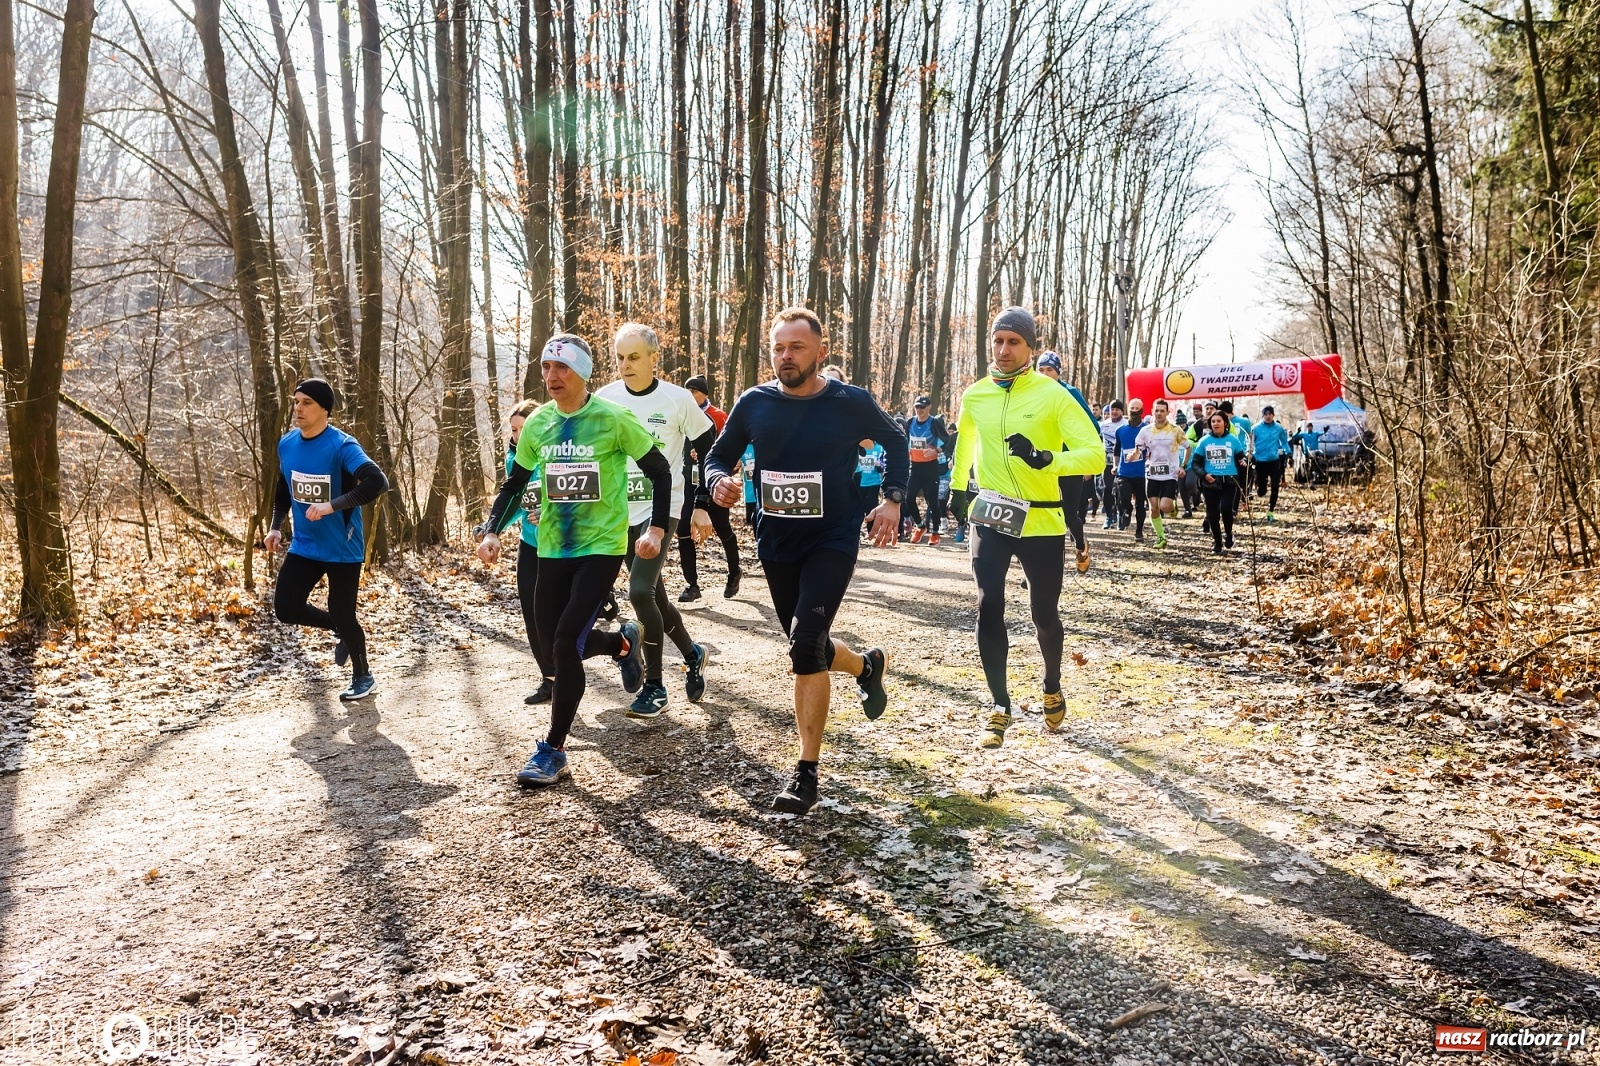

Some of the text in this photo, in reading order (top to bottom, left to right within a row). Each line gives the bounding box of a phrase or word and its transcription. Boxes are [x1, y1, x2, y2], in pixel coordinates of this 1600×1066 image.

[1200, 374, 1264, 384] TWARDZIELA
[1208, 384, 1257, 394] RACIBÓRZ
[540, 439, 595, 460] synthos
[297, 482, 322, 496] 090
[556, 475, 588, 491] 027
[772, 486, 809, 504] 039
[984, 503, 1014, 524] 102
